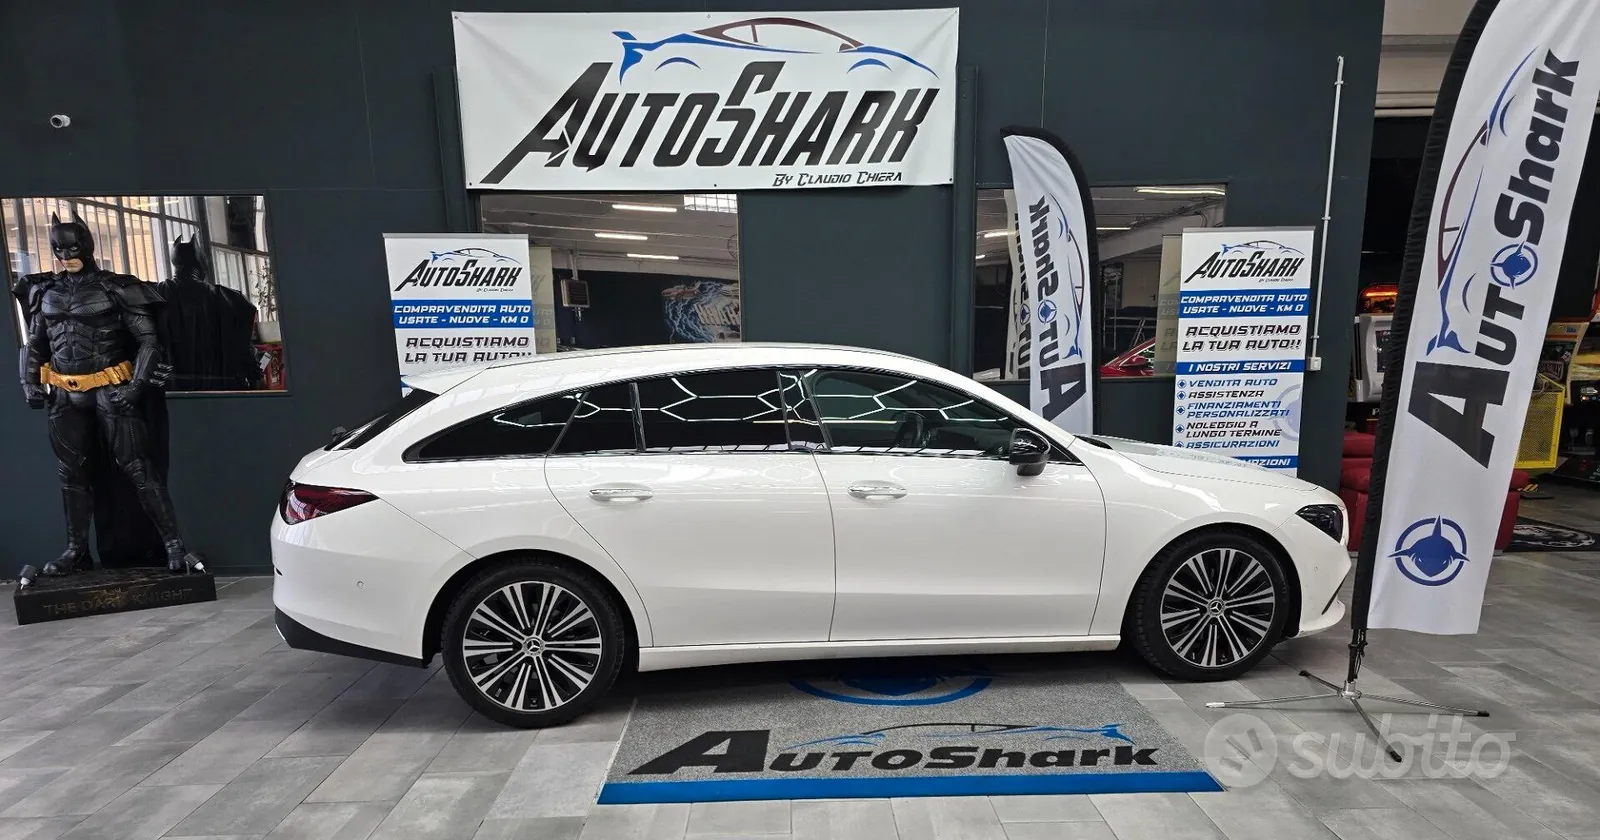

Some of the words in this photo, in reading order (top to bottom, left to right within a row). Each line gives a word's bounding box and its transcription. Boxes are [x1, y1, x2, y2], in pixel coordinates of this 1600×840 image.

[1180, 294, 1276, 304] COMPRAVENDITA
[1277, 293, 1308, 302] AUTO
[394, 305, 497, 314] COMPRAVENDITA
[499, 304, 531, 313] AUTO
[1183, 305, 1220, 314] USATE
[1229, 304, 1268, 313] NUOVE
[1276, 304, 1293, 312] KM
[399, 316, 439, 325] USATE
[449, 315, 490, 324] NUOVE
[500, 315, 518, 324] KM
[1185, 324, 1302, 338] ACQUISTIAMO
[405, 336, 530, 349] ACQUISTIAMO
[1182, 340, 1204, 352] LA
[1208, 339, 1241, 351] TUA
[1245, 339, 1302, 350] AUTO!!
[404, 352, 427, 363] LA
[432, 352, 467, 362] TUA
[1188, 364, 1193, 373] I
[1196, 363, 1240, 372] NOSTRI
[1242, 361, 1292, 371] SERVIZI
[1188, 379, 1242, 388] VENDITA
[1244, 378, 1278, 387] AUTO
[1188, 390, 1265, 399] ASSISTENZA
[1187, 400, 1281, 410] FINANZIAMENTI
[1186, 409, 1290, 418] PERSONALIZZATI
[1186, 421, 1247, 430] NOLEGGIO
[1249, 420, 1259, 429] A
[1186, 430, 1227, 439] LUNGO
[1229, 429, 1283, 438] TERMINE
[1185, 440, 1280, 449] ASSICURAZIONI
[44, 601, 78, 617] THE
